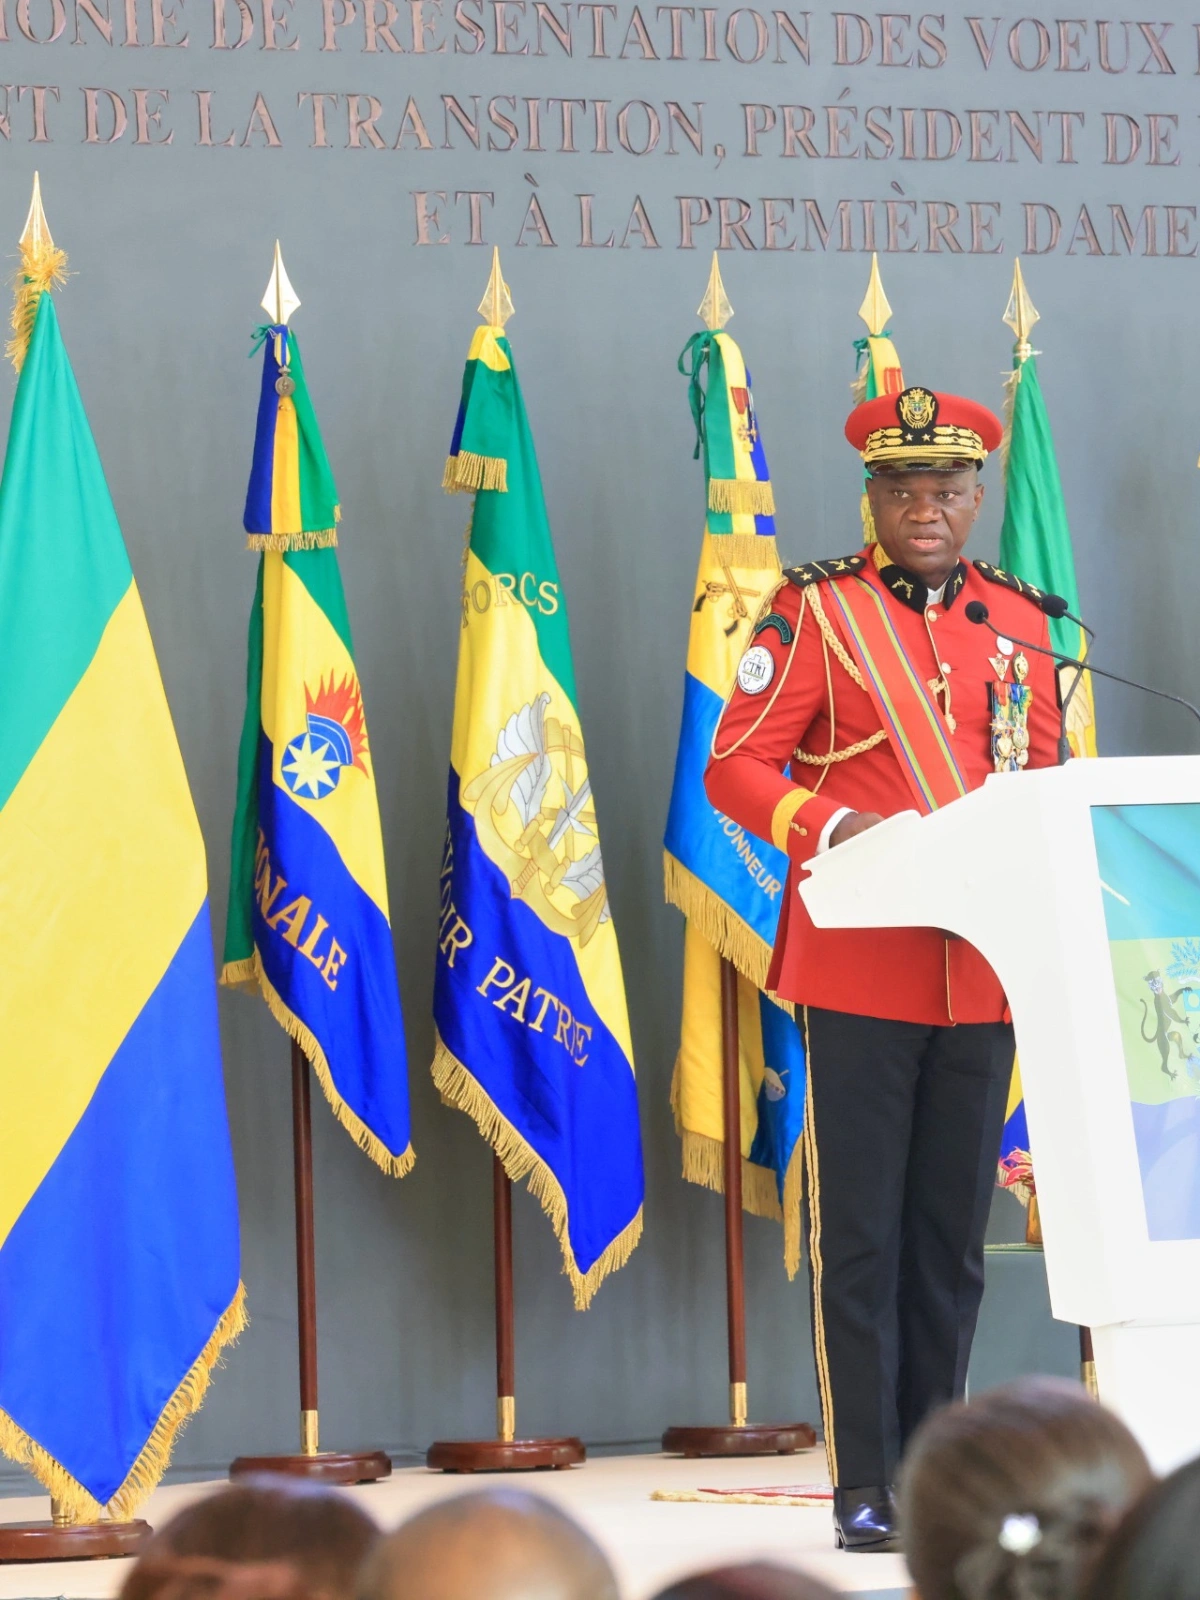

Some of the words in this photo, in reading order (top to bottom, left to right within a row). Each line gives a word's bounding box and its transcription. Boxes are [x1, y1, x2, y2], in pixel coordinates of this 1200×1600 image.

[0, 0, 190, 48] ONIE
[209, 0, 301, 51] DE
[831, 12, 946, 69] DES
[964, 16, 1177, 76] VOEUX
[79, 87, 175, 146] DE
[192, 90, 284, 149] LA
[298, 92, 726, 169] TRANSITION,
[740, 87, 1086, 166] PRÉSIDENT
[1101, 110, 1182, 168] DE
[411, 190, 495, 247] ET
[517, 172, 558, 249] À
[574, 194, 661, 250] LA
[676, 181, 1004, 257] PREMIÈRE
